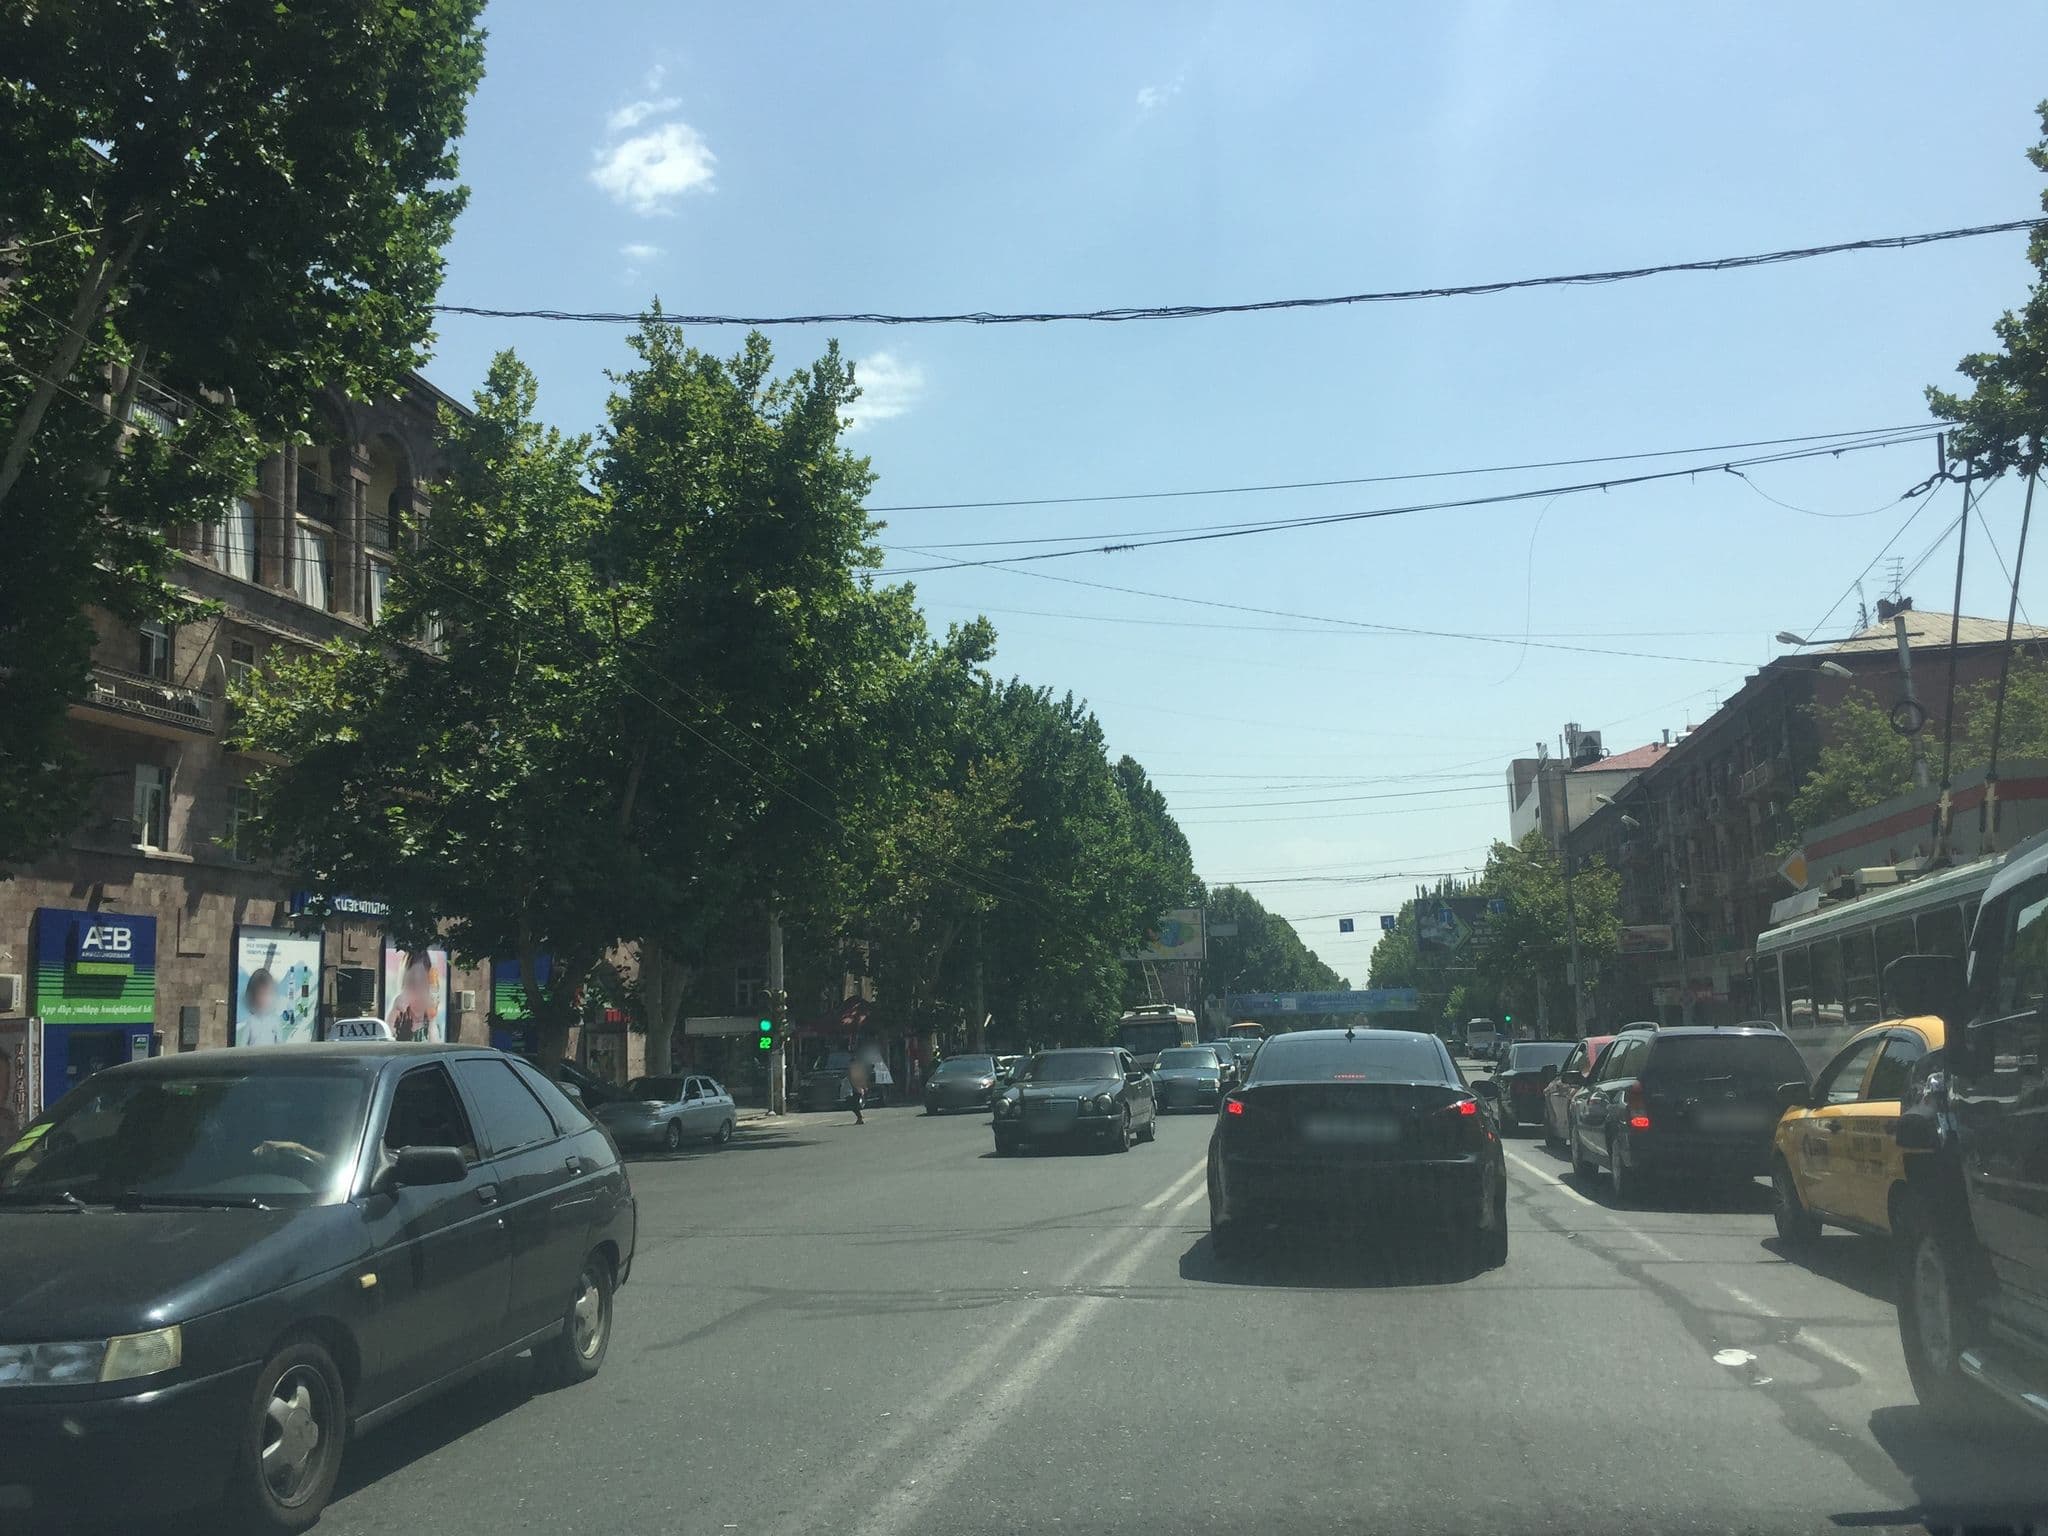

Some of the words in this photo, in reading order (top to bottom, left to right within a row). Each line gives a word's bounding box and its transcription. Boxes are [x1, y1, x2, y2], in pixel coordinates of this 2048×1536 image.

[82, 926, 132, 950] AEB
[337, 1023, 377, 1037] TAXI
[760, 1037, 771, 1048] 22
